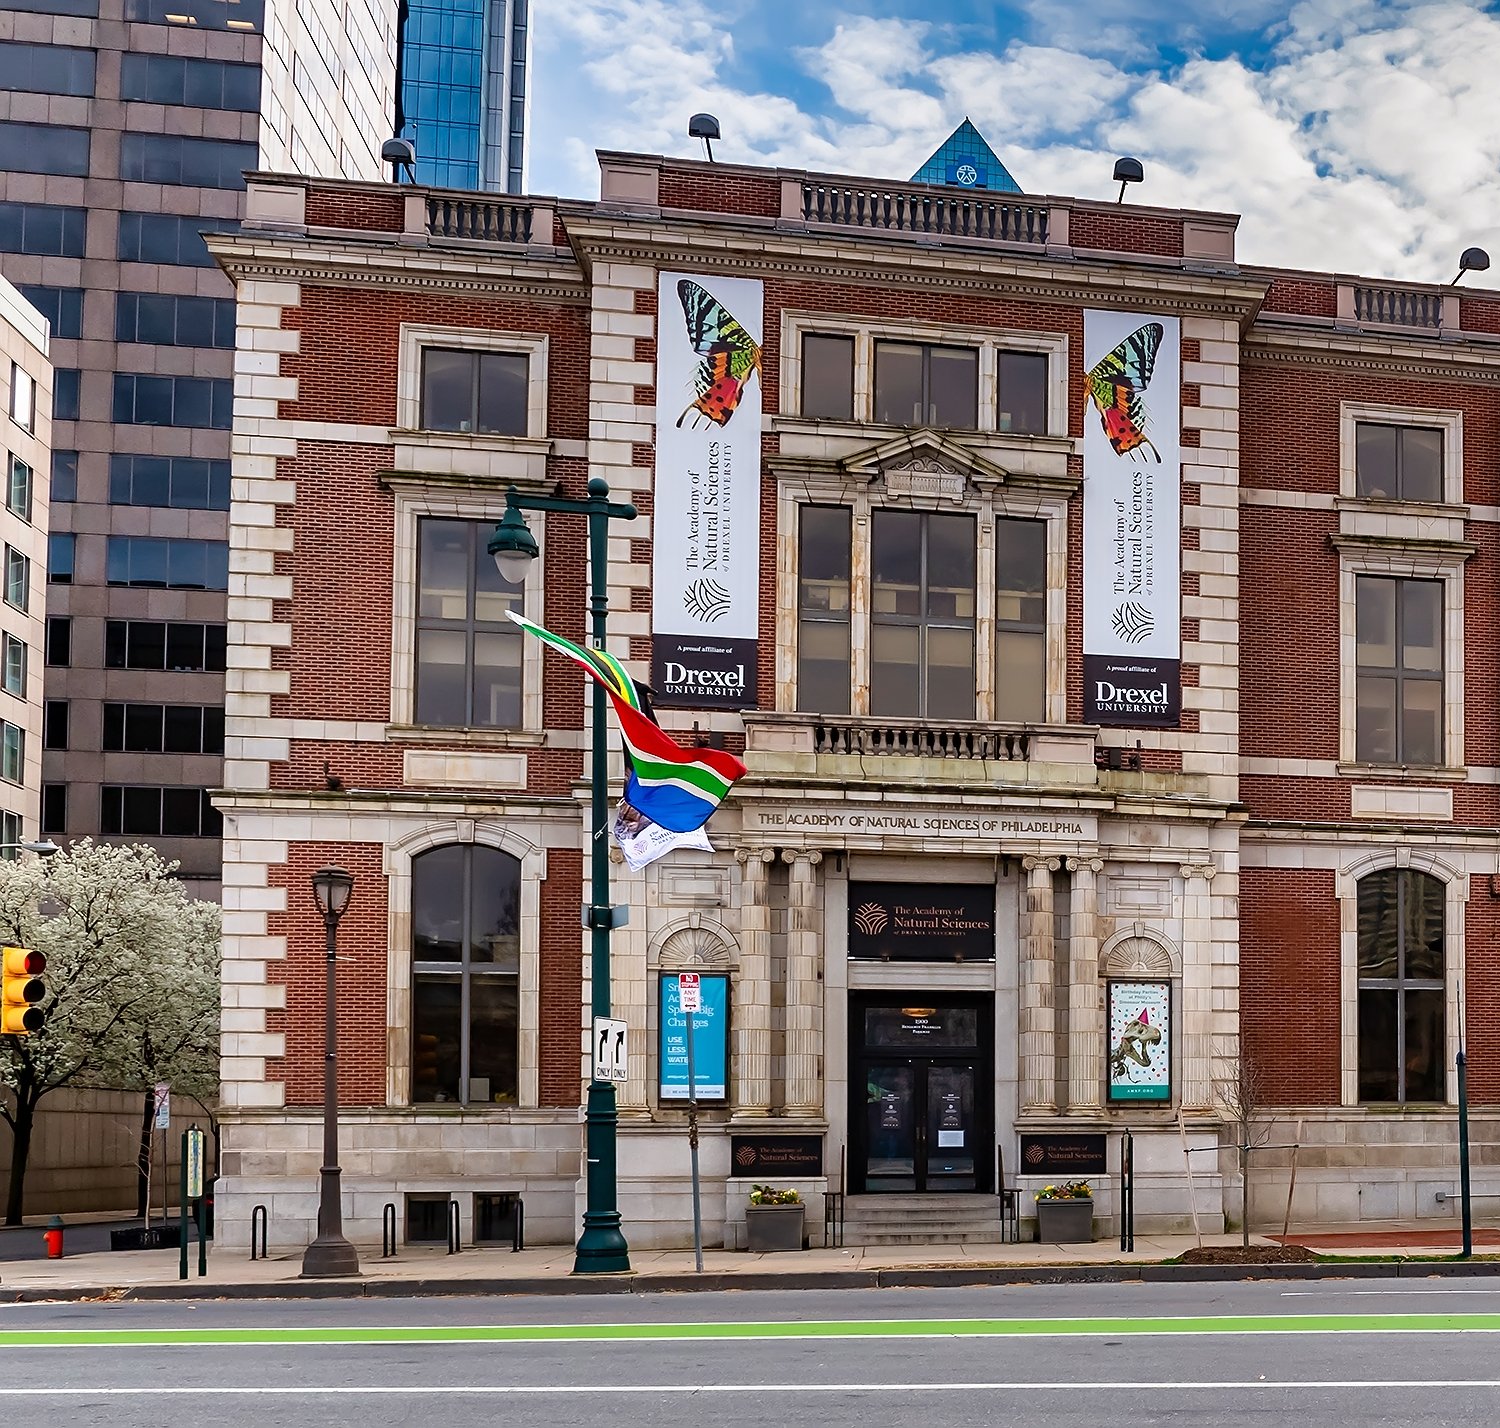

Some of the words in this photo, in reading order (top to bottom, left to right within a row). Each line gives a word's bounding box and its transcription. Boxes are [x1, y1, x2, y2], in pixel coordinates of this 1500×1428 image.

[687, 469, 699, 484] of
[704, 441, 719, 506] Sciences
[723, 443, 731, 512] UNIVERSITY
[1113, 498, 1124, 512] of
[1129, 471, 1142, 533] Sciences
[686, 487, 702, 543] Academy
[703, 511, 718, 571] Natural
[722, 516, 731, 561] DREXEL
[1113, 515, 1127, 568] Academy
[686, 546, 698, 571] The
[1128, 538, 1142, 594] Natural
[1113, 571, 1124, 595] The
[663, 661, 746, 688] Drexel
[665, 684, 743, 697] UNIVERSITY
[1095, 681, 1169, 705] Drexel
[1097, 703, 1167, 714] UNIVERSITY
[758, 813, 784, 825] THE
[786, 814, 845, 826] ACADEMY
[849, 816, 865, 827] OF
[867, 816, 920, 829] NATURAL
[923, 818, 979, 830] SCIENCES
[982, 820, 998, 831] OF
[1001, 821, 1083, 834] PHILADELPHIA
[893, 906, 911, 915] The
[913, 906, 952, 917] Academy
[954, 907, 965, 915] of
[894, 916, 939, 928] Natural
[941, 917, 990, 929] Sciences
[668, 1018, 709, 1029] Chages
[597, 1066, 610, 1076] ONLY
[614, 1068, 626, 1078] ONLY
[760, 1153, 787, 1161] Natural
